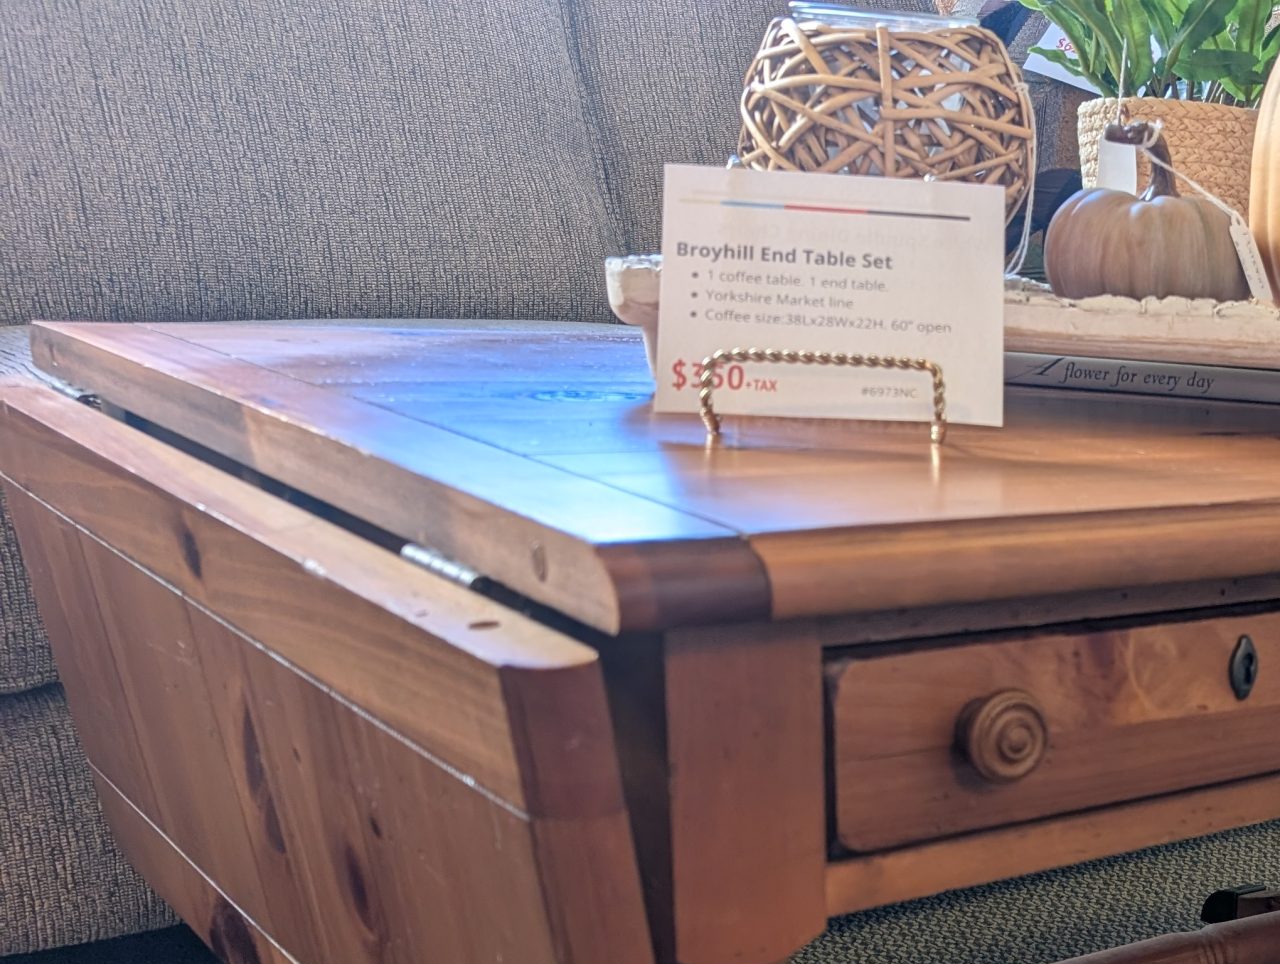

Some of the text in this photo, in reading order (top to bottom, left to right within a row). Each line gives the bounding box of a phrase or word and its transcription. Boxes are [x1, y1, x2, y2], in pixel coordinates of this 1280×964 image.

[676, 242, 893, 270] Broyhill End Table Set
[719, 271, 762, 285] coffee
[810, 276, 816, 287] 1
[821, 278, 847, 290] end
[705, 289, 854, 309] Yorkshire Market line
[704, 309, 751, 323] Coffee
[917, 323, 952, 335] open
[1058, 361, 1110, 384] flower
[1110, 365, 1138, 388] for
[1143, 373, 1181, 391] every
[1186, 371, 1216, 394] day
